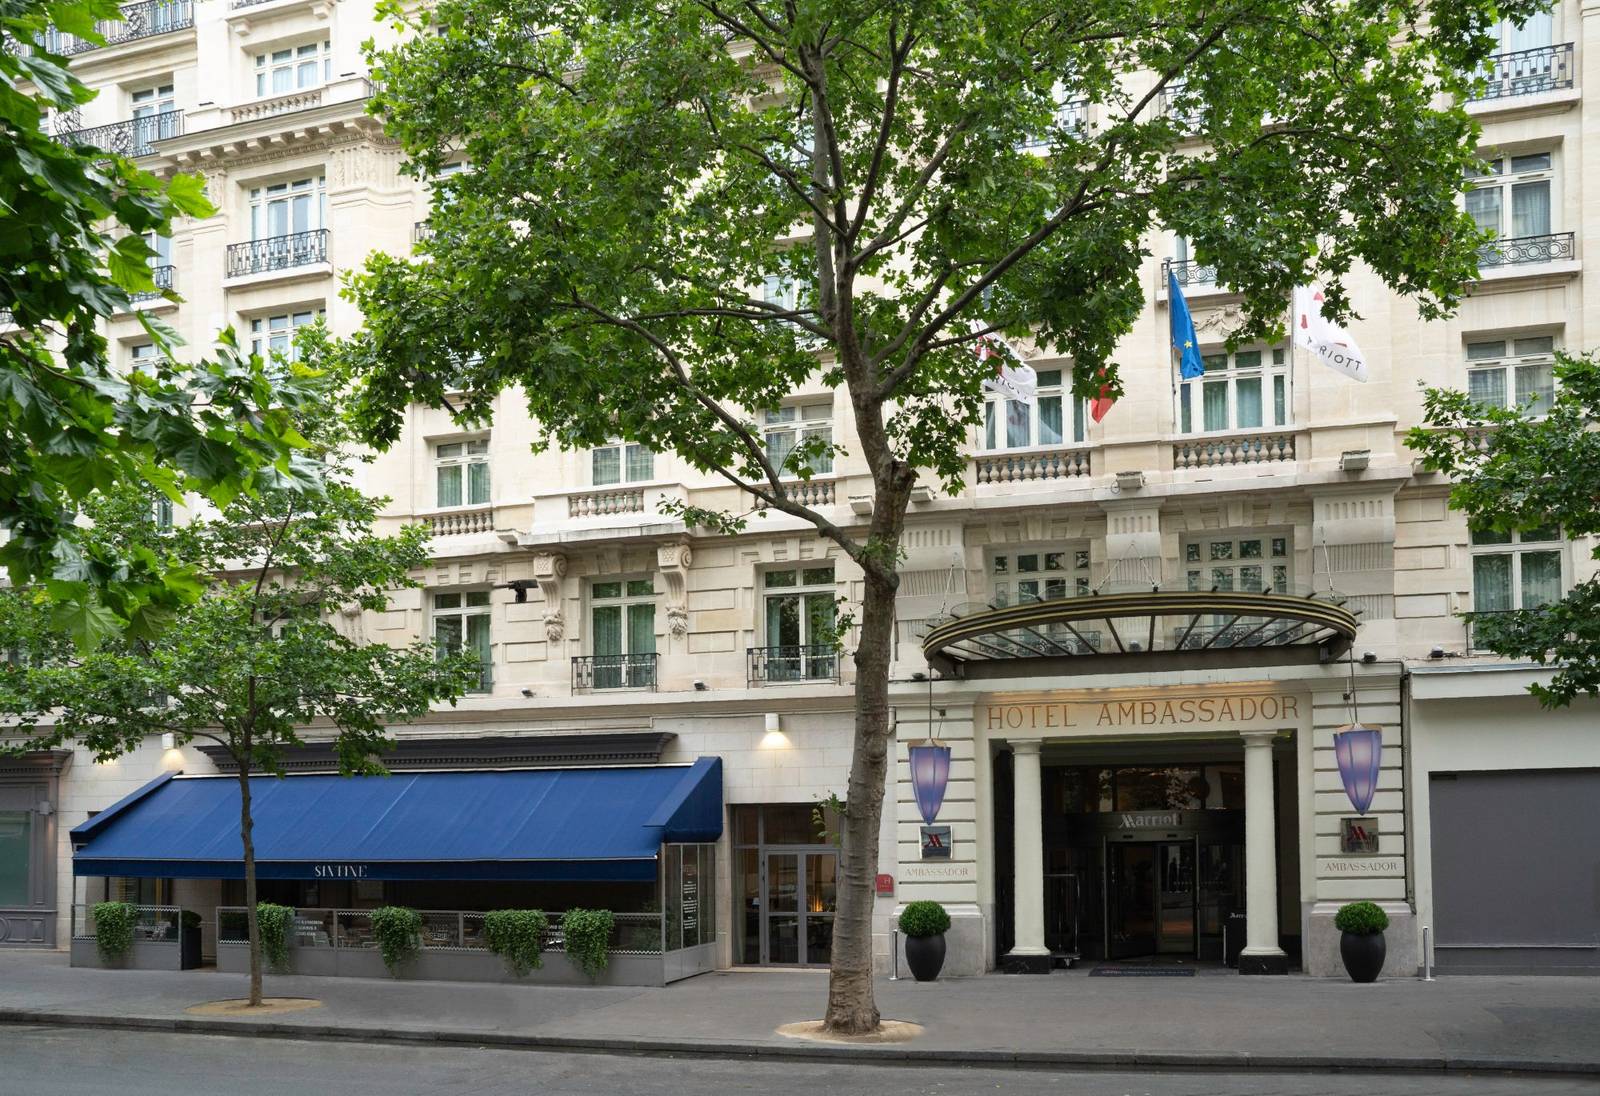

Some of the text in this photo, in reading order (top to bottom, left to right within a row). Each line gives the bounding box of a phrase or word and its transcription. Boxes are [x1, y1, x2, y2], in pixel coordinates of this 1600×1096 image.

[987, 695, 1300, 730] HOTEL AMBASSADOR
[905, 867, 969, 877] AMBASSADOR
[1325, 862, 1398, 872] AMBASSADOR
